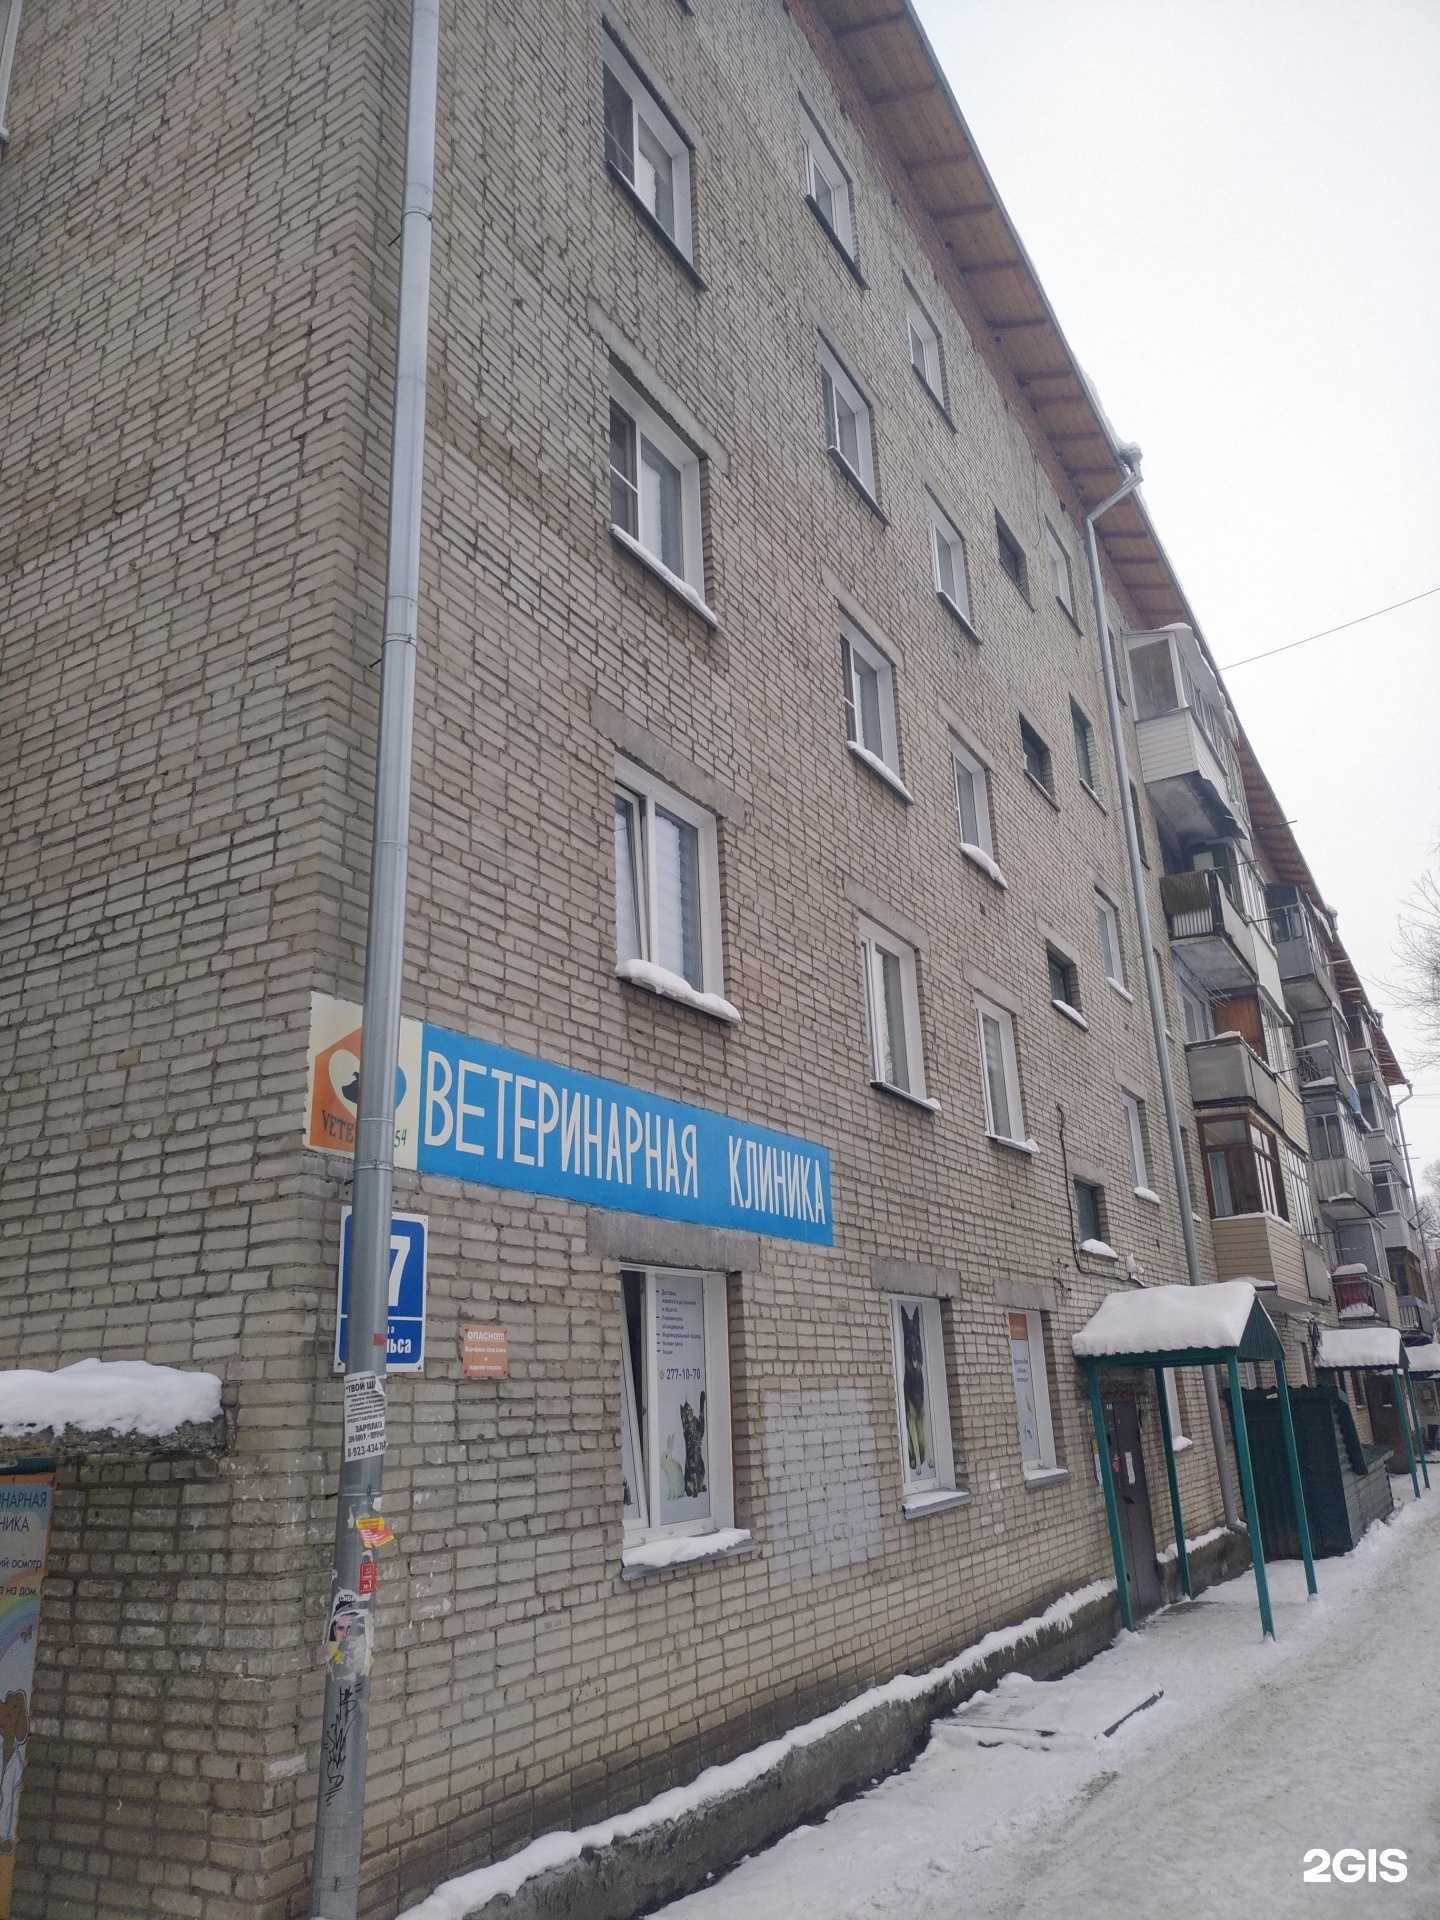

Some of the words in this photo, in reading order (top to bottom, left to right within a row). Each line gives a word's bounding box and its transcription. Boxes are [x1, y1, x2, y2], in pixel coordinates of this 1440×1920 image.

[321, 1109, 355, 1143] VETE
[423, 1049, 699, 1199] ВЕТЕРИНАРНАЯ
[727, 1135, 826, 1225] КЛИНИКА
[388, 1234, 411, 1307] 7
[666, 1367, 701, 1380] 277-10-70
[0, 1491, 48, 1509] НАРНАЯ
